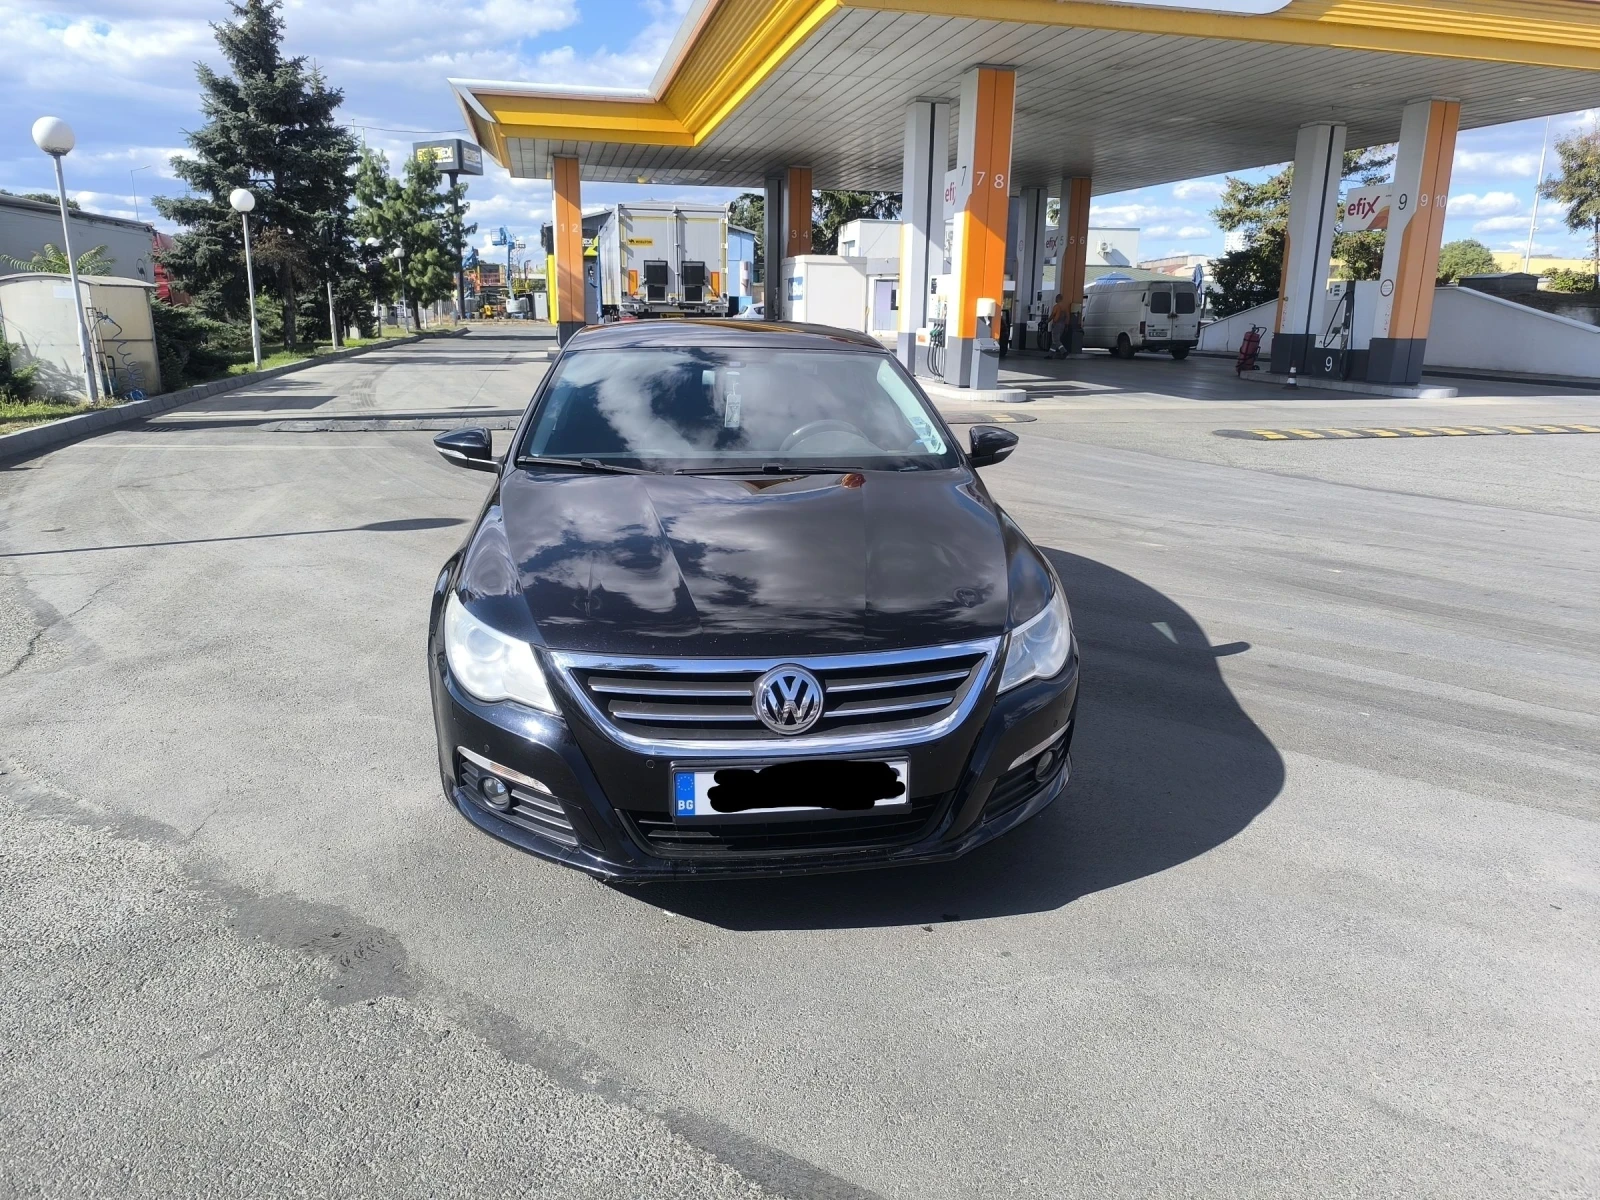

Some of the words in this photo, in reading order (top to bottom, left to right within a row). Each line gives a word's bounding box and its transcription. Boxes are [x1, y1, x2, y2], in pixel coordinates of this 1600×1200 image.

[961, 166, 967, 186] 7
[976, 171, 986, 186] 7
[994, 174, 1004, 188] 8
[945, 182, 957, 205] efi
[1398, 193, 1408, 210] 9
[1420, 194, 1428, 206] 9
[1435, 195, 1447, 208] 10
[1347, 196, 1380, 219] efix
[572, 224, 579, 232] 2
[791, 230, 797, 238] 3
[1046, 236, 1059, 250] efix
[1069, 236, 1075, 244] 5
[1080, 237, 1085, 245] 6
[1325, 356, 1333, 372] 9
[759, 669, 820, 731] VW
[678, 800, 694, 810] BG
